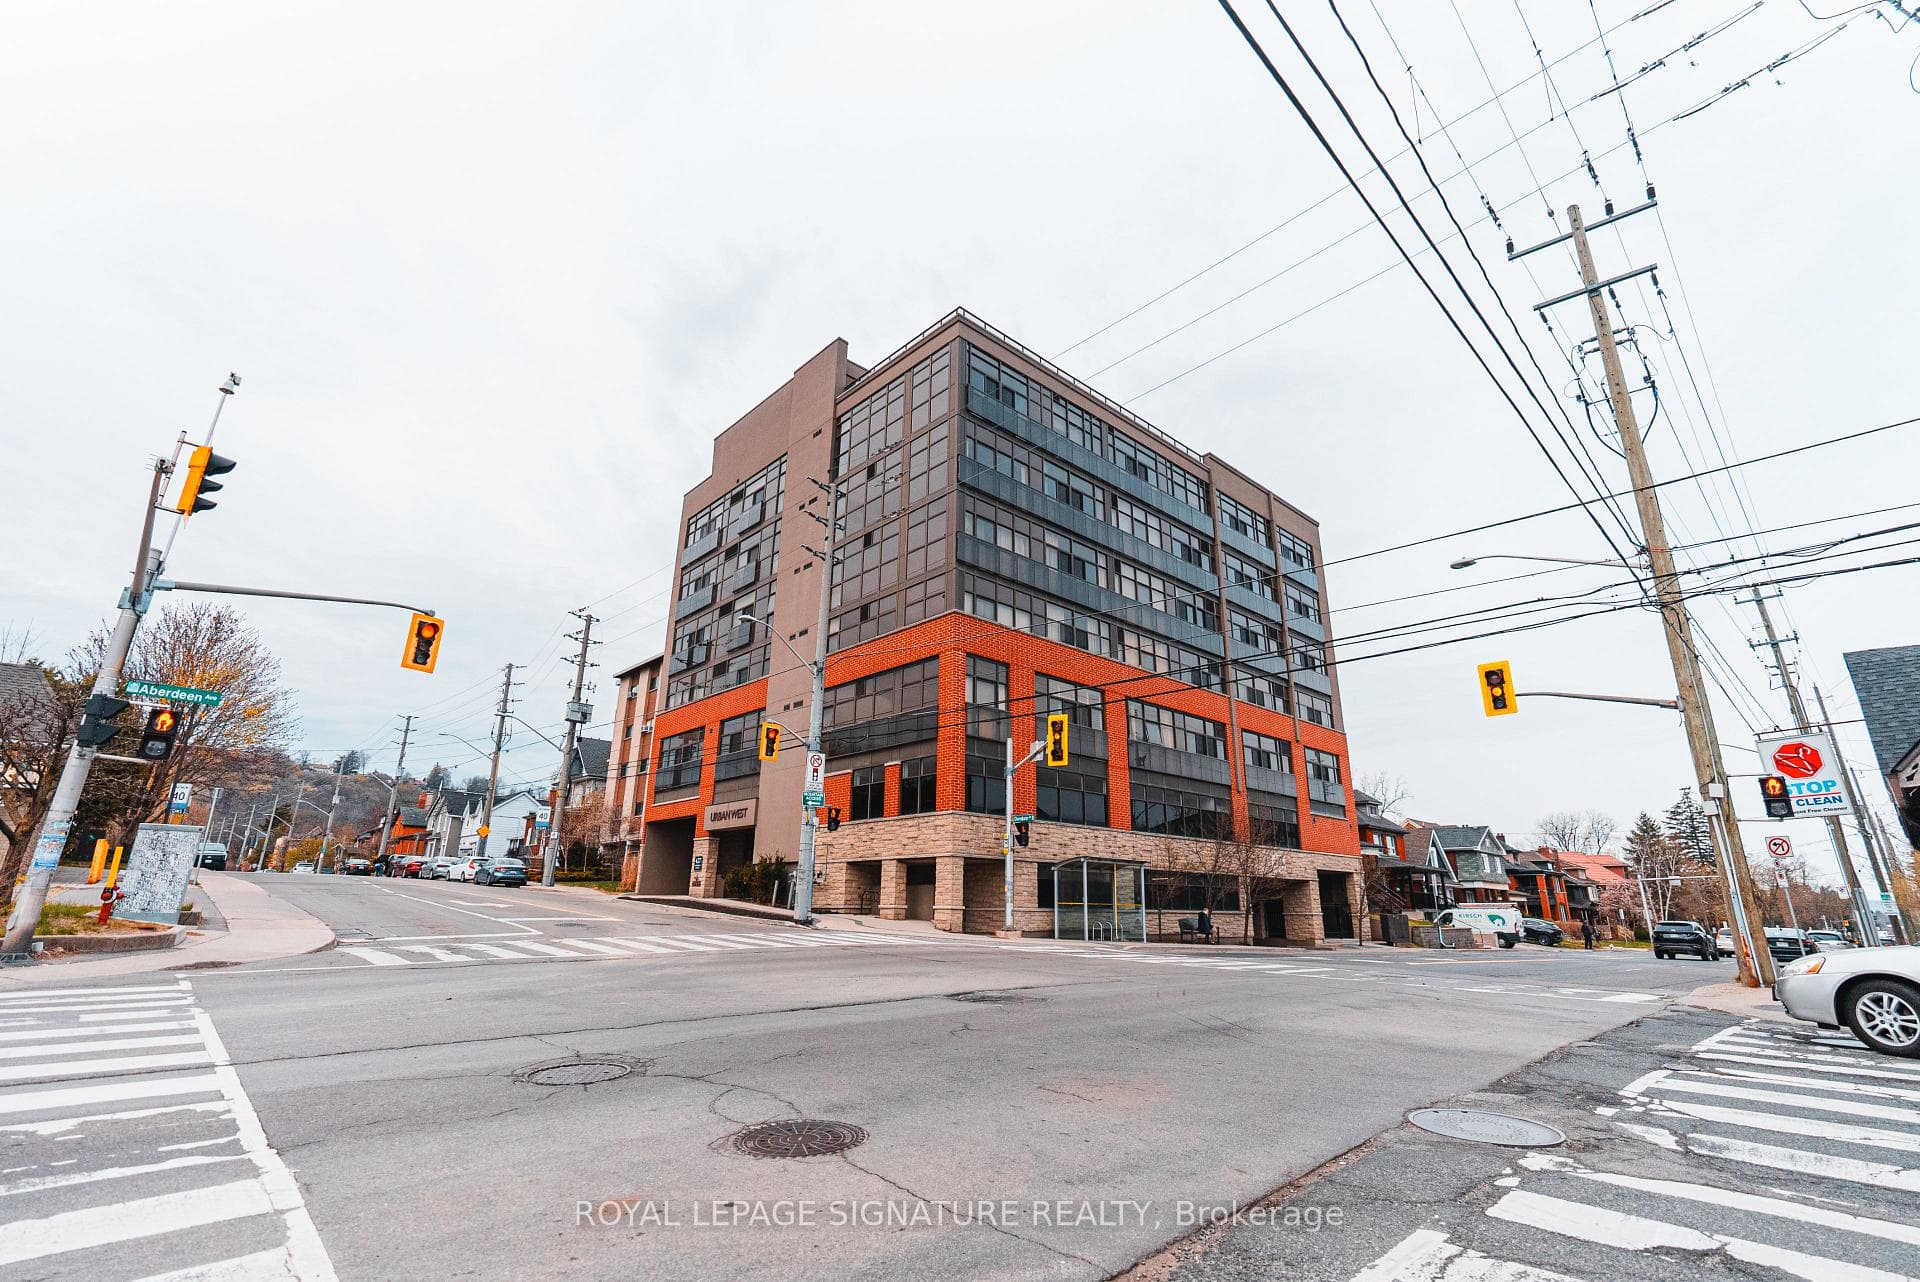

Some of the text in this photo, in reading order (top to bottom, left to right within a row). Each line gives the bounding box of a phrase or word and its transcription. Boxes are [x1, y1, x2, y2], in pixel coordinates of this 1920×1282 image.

[139, 684, 202, 702] Aberdeen
[173, 791, 186, 801] 40
[1796, 795, 1843, 807] CLEAN
[539, 812, 548, 820] 40
[710, 807, 748, 822] URBAN WEST
